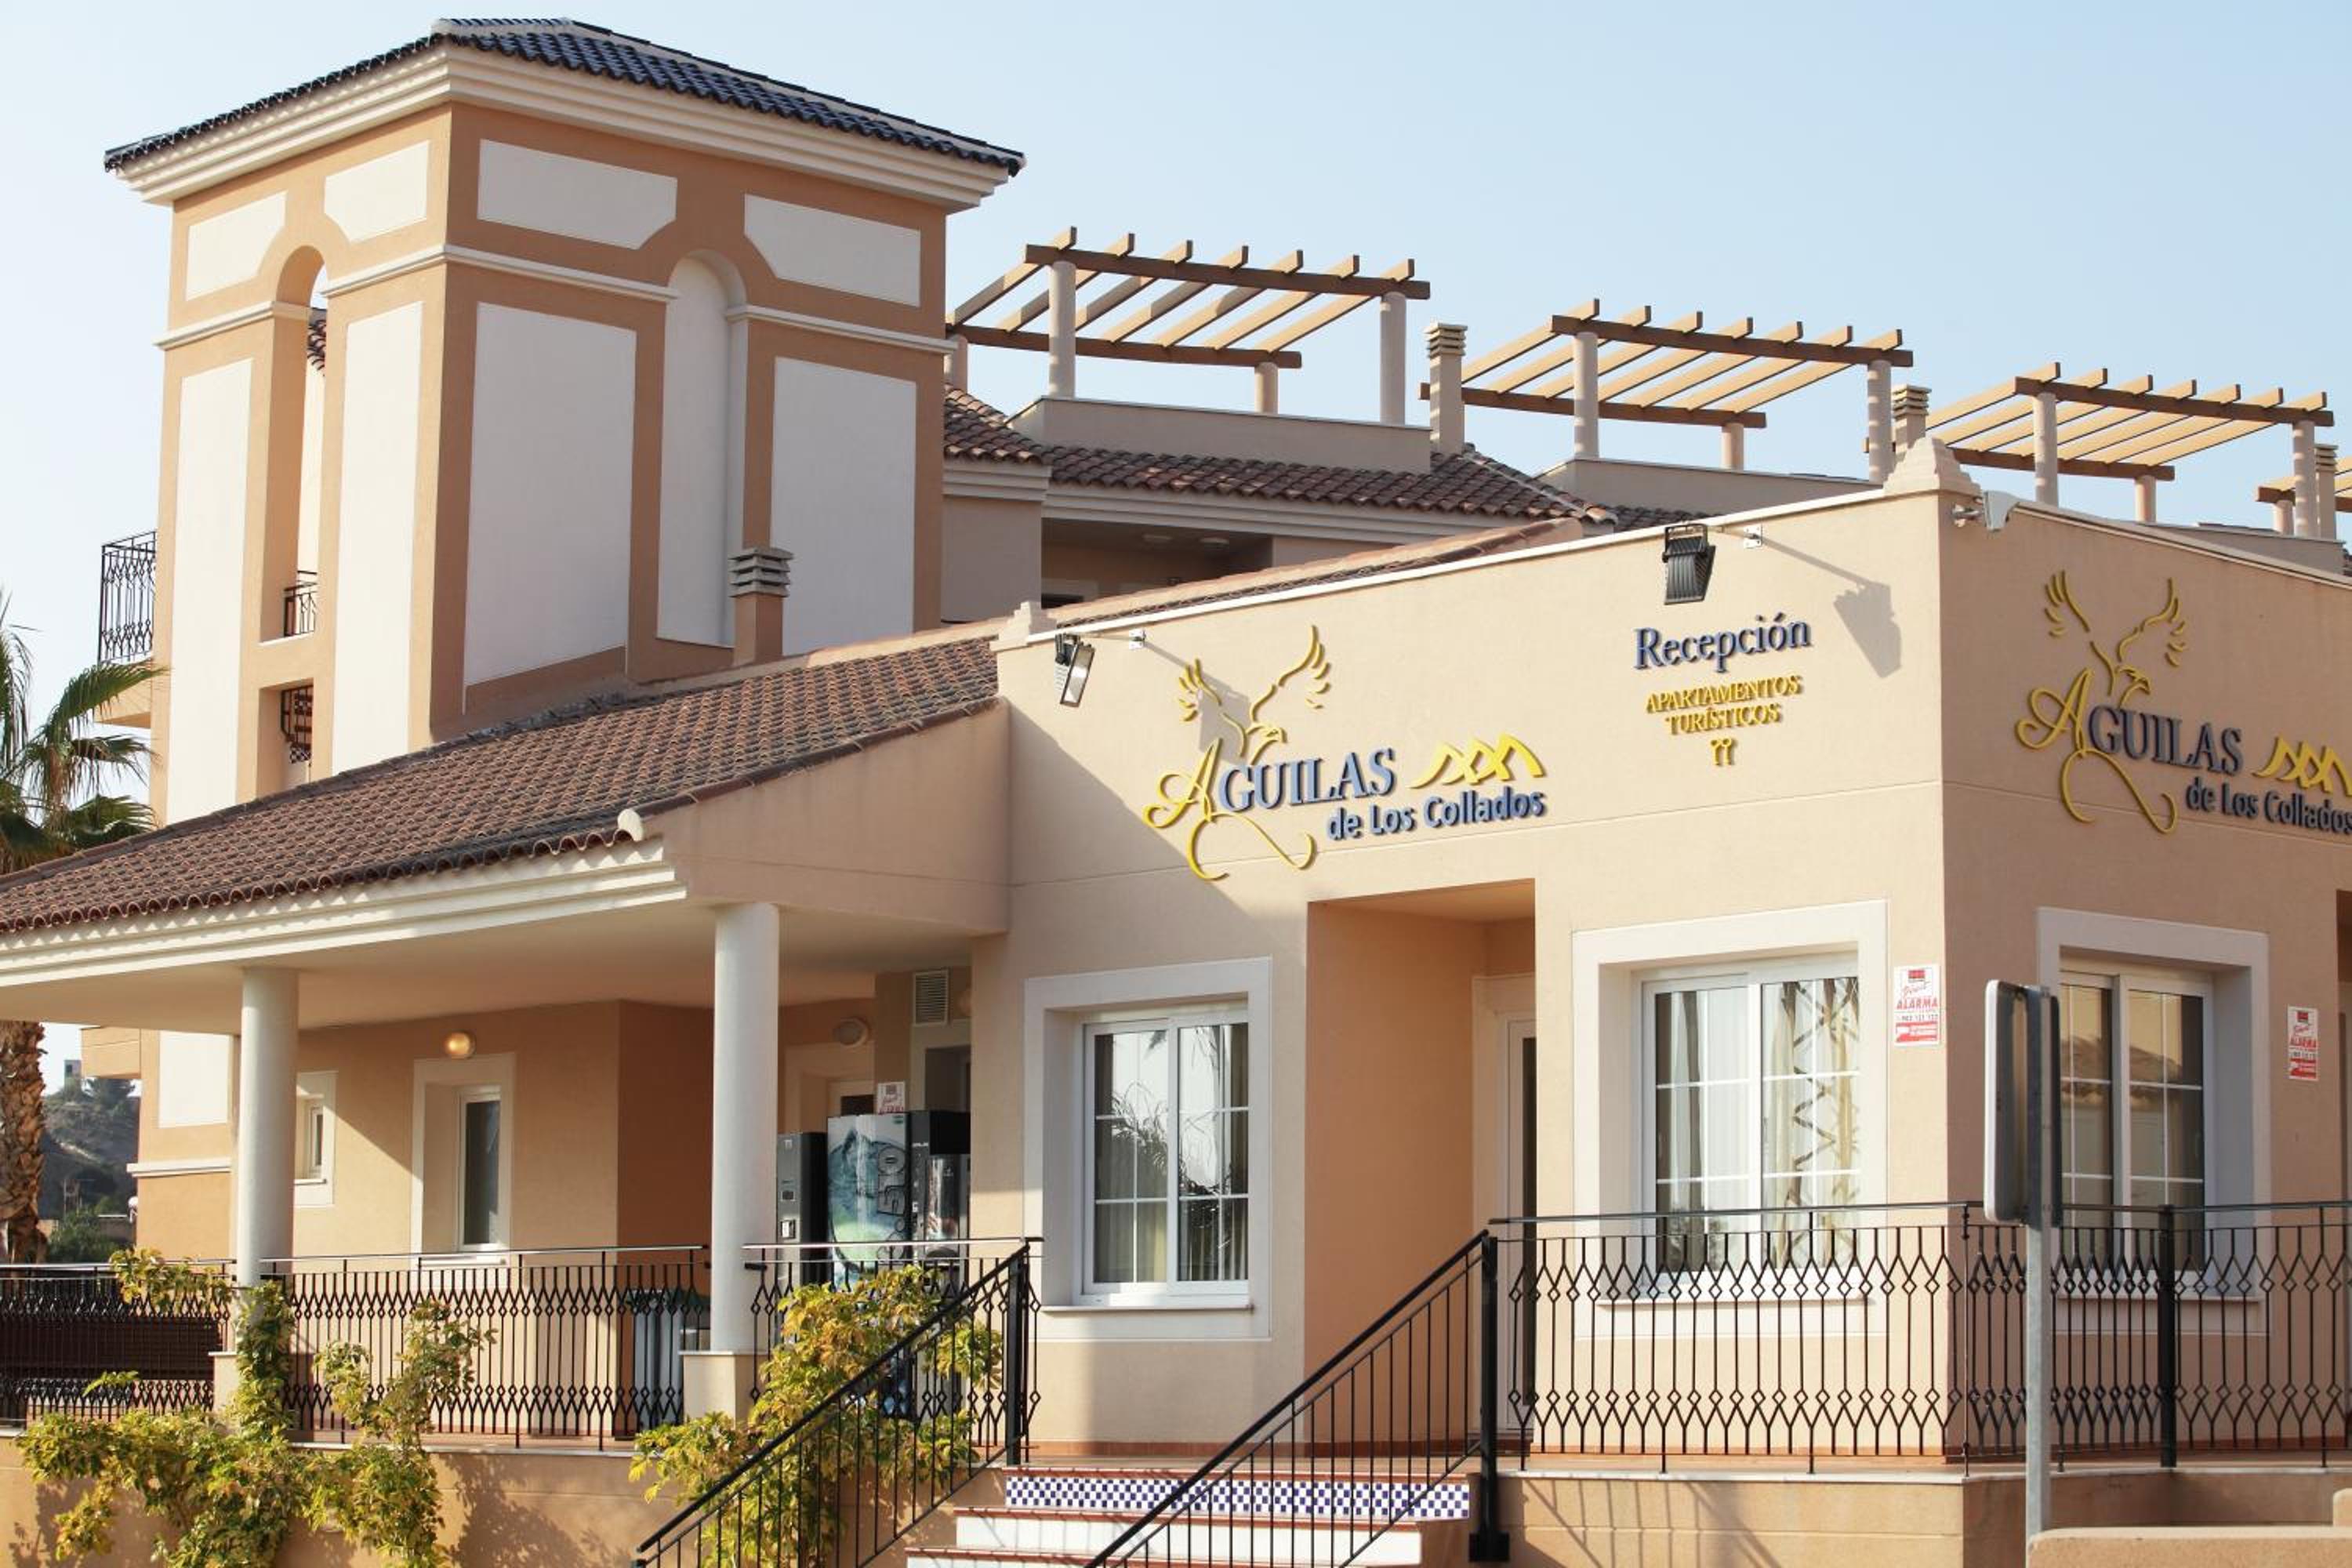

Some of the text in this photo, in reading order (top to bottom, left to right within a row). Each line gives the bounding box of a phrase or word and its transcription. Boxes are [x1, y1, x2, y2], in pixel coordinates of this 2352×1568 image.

[1634, 612, 1812, 673] Recepción
[1646, 675, 1802, 713] APARTAMENTOS
[2015, 666, 2243, 777] AGUILAS
[1142, 739, 1396, 831] AGUILAS
[1327, 786, 1546, 840] de Los Collados
[2186, 777, 2352, 836] de Los Collados
[1896, 996, 1939, 1010] ALARMA
